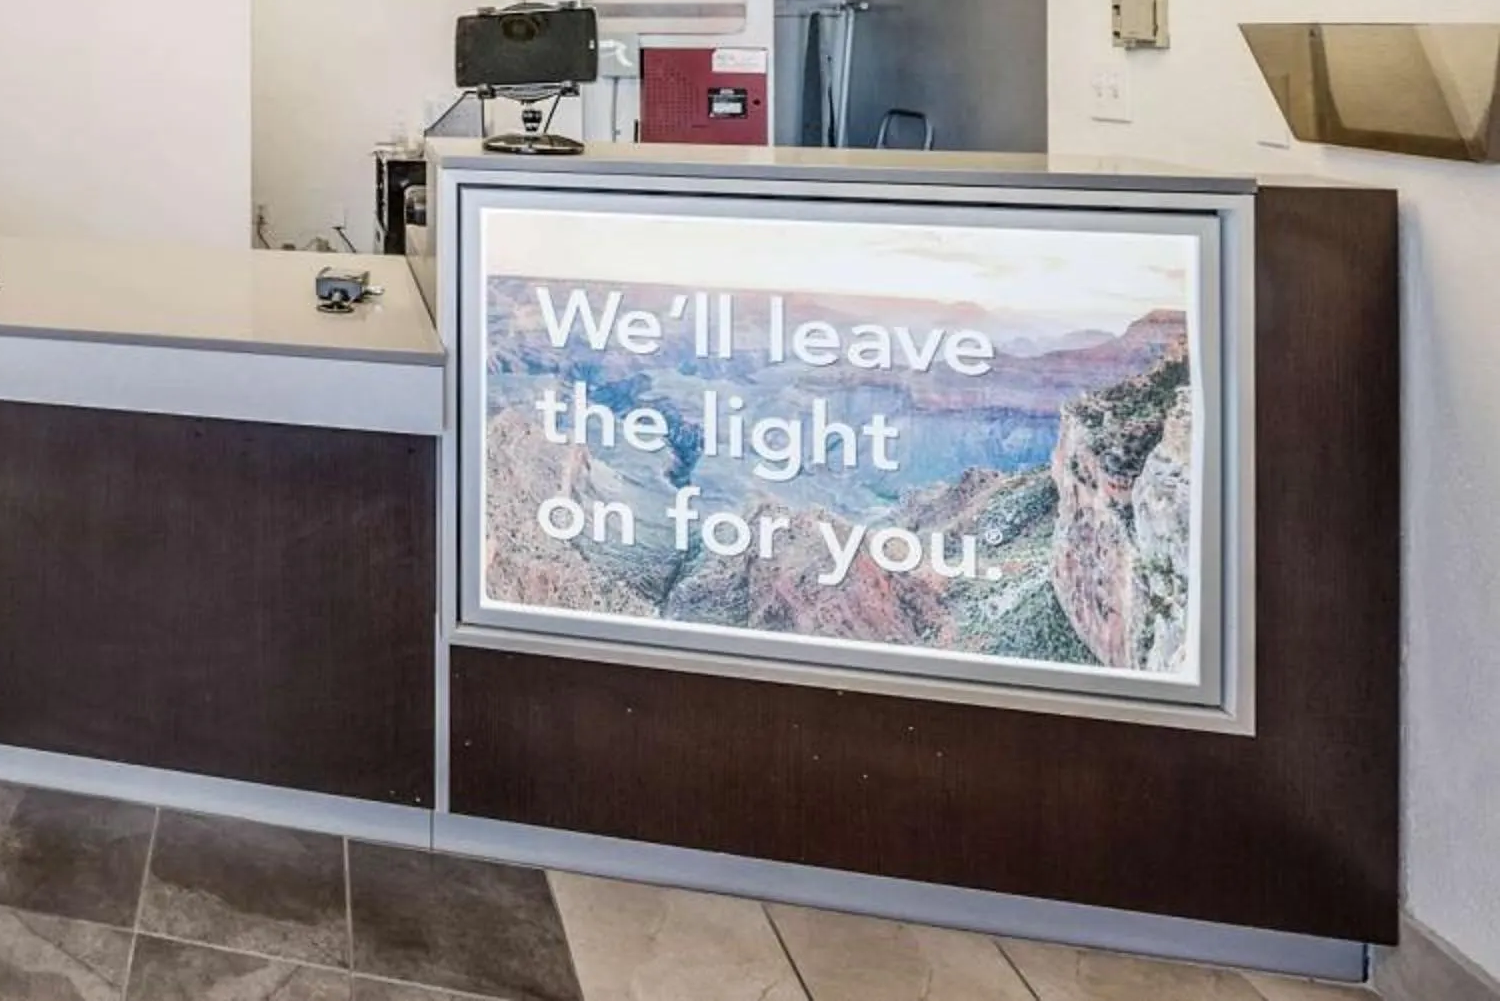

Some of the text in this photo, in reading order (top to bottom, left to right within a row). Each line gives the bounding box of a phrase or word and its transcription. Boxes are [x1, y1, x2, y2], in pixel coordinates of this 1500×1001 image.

[535, 286, 995, 376] We'll leave
[536, 381, 901, 481] the light
[537, 486, 1002, 587] on for you.
